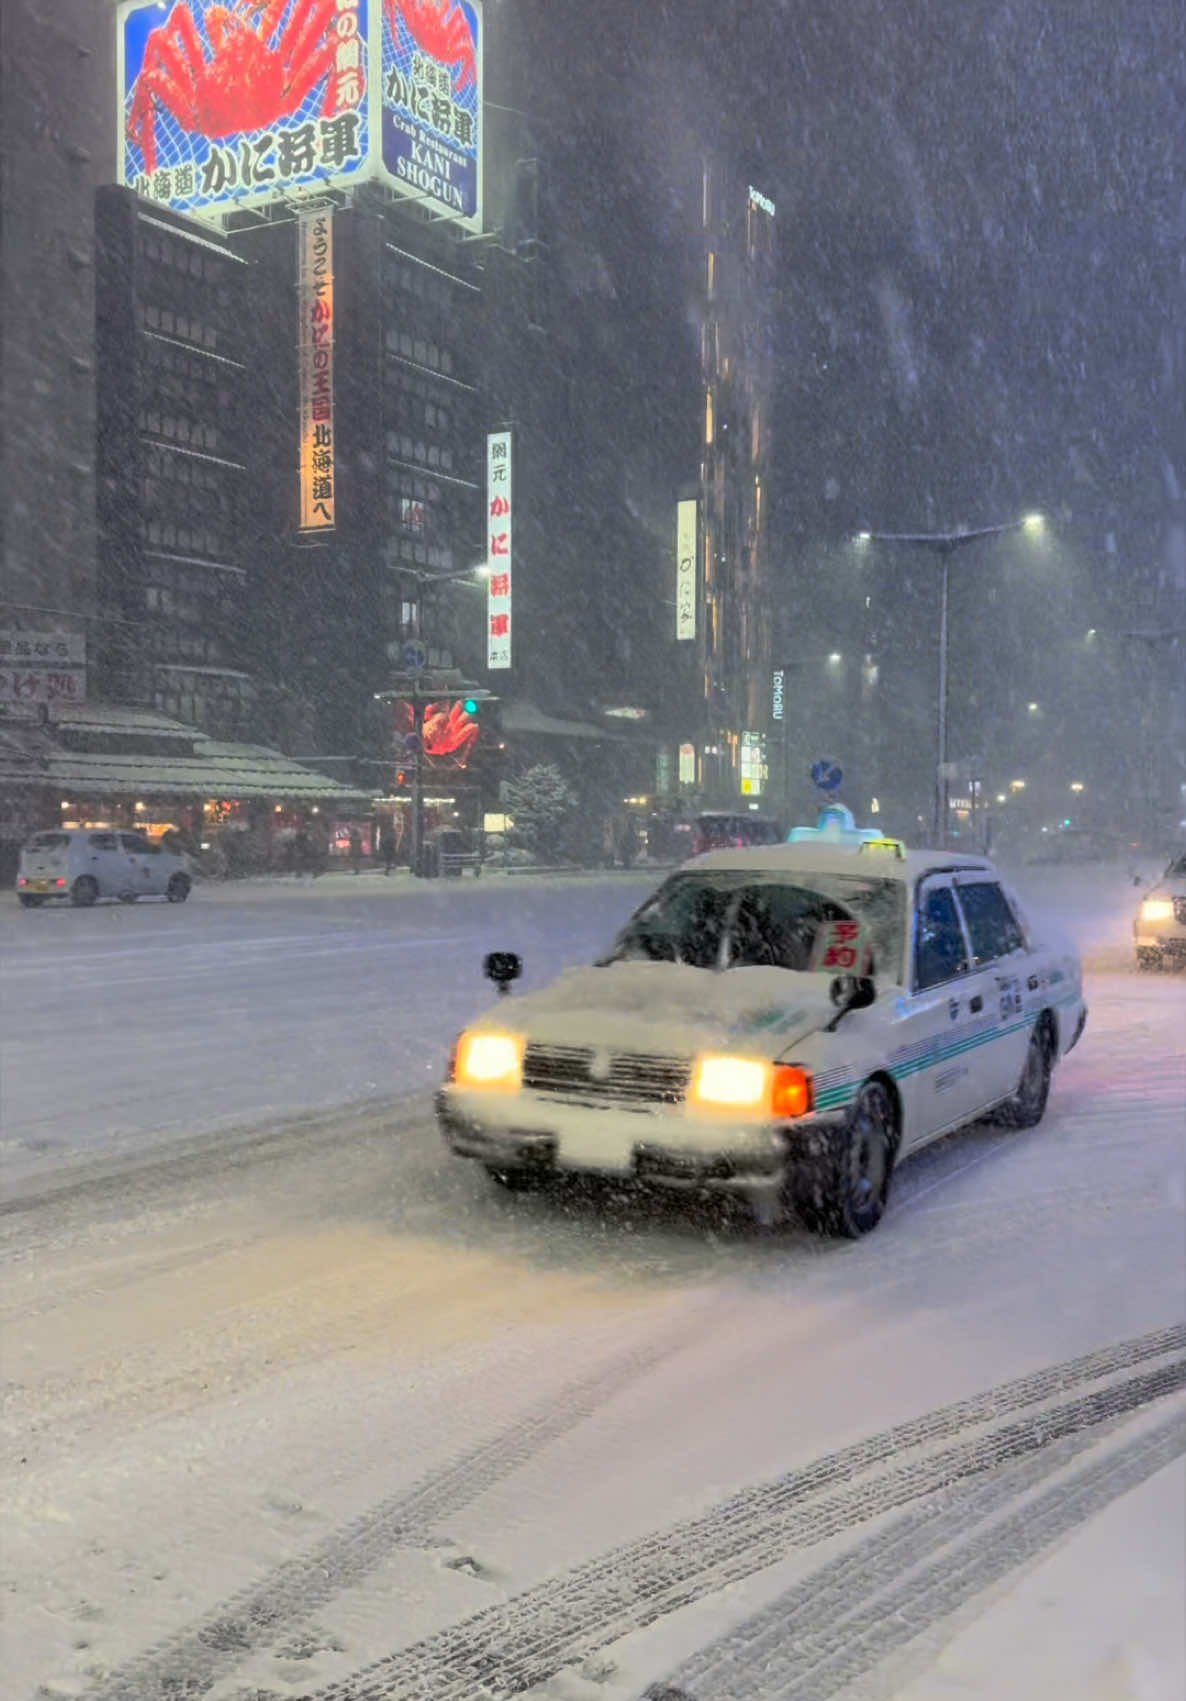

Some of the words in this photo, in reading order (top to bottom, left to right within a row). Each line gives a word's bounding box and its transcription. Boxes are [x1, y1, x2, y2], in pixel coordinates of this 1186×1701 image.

[386, 66, 474, 147] かに将軍
[393, 113, 417, 139] Crab
[202, 113, 359, 194] かに将軍
[397, 156, 464, 210] SHOGUN
[411, 140, 451, 181] KANI
[490, 496, 511, 637] かに将軍
